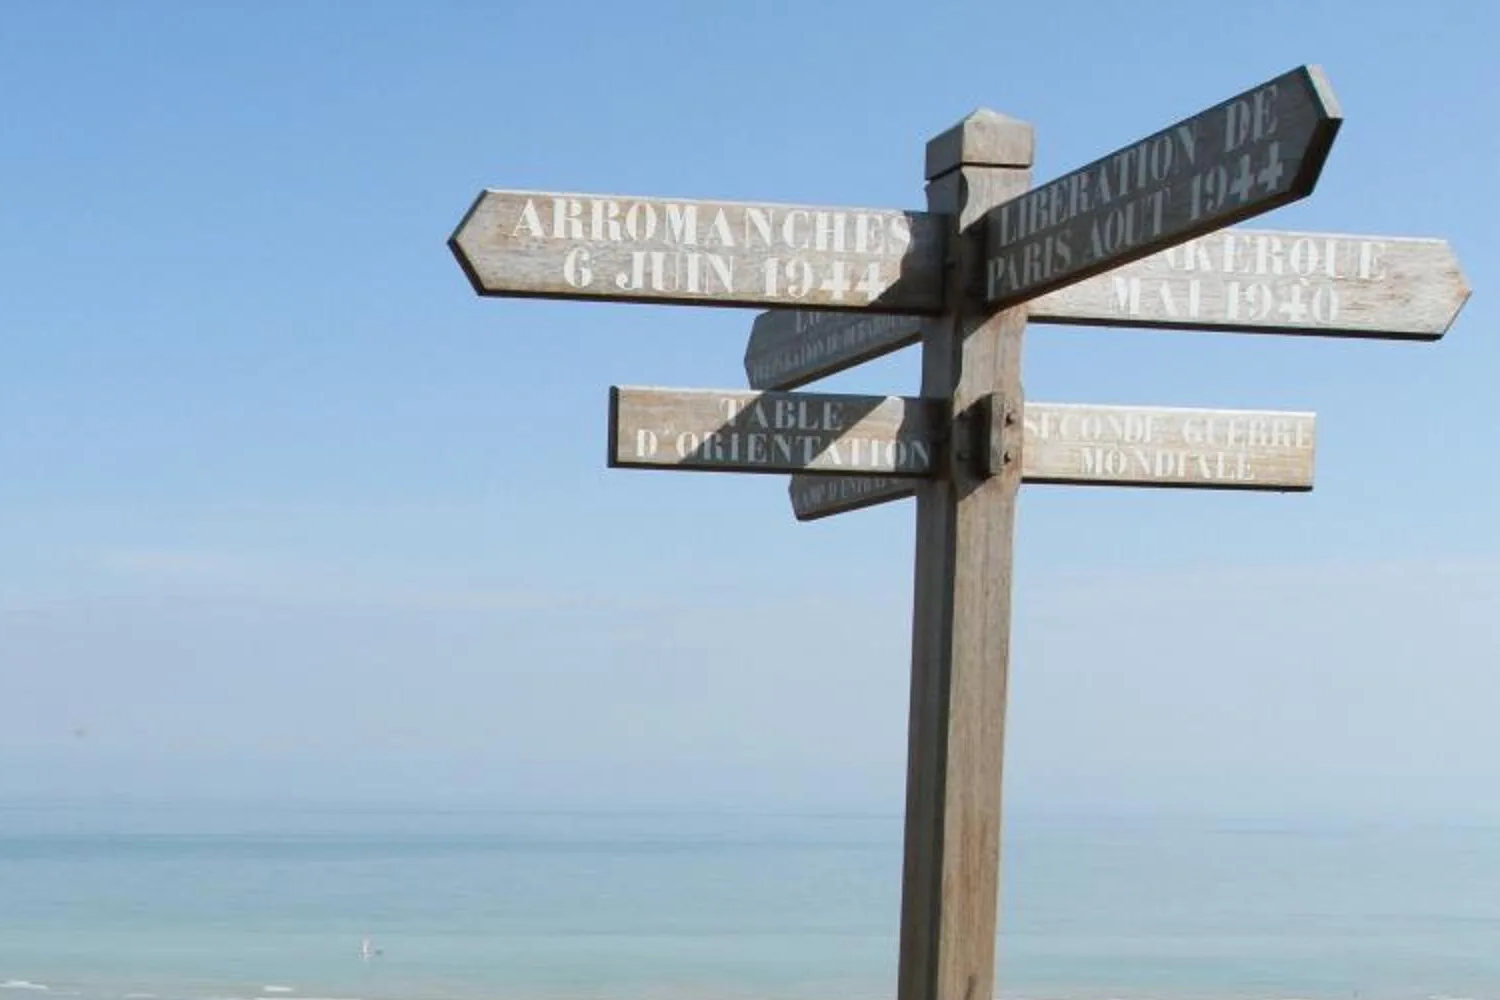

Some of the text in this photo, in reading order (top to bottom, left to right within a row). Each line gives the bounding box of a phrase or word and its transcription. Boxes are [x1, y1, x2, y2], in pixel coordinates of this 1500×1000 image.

[999, 82, 1280, 246] LIBERATION DE
[514, 198, 912, 254] ARROMANCHES
[987, 228, 1072, 301] PARIS
[1189, 141, 1283, 222] 1944
[563, 243, 886, 302] 6 JUIN 1944
[1110, 275, 1341, 325] MAI 1940
[719, 398, 845, 431] TABLE
[1182, 414, 1314, 449] GUERRE
[1081, 446, 1256, 481] MONDIALE
